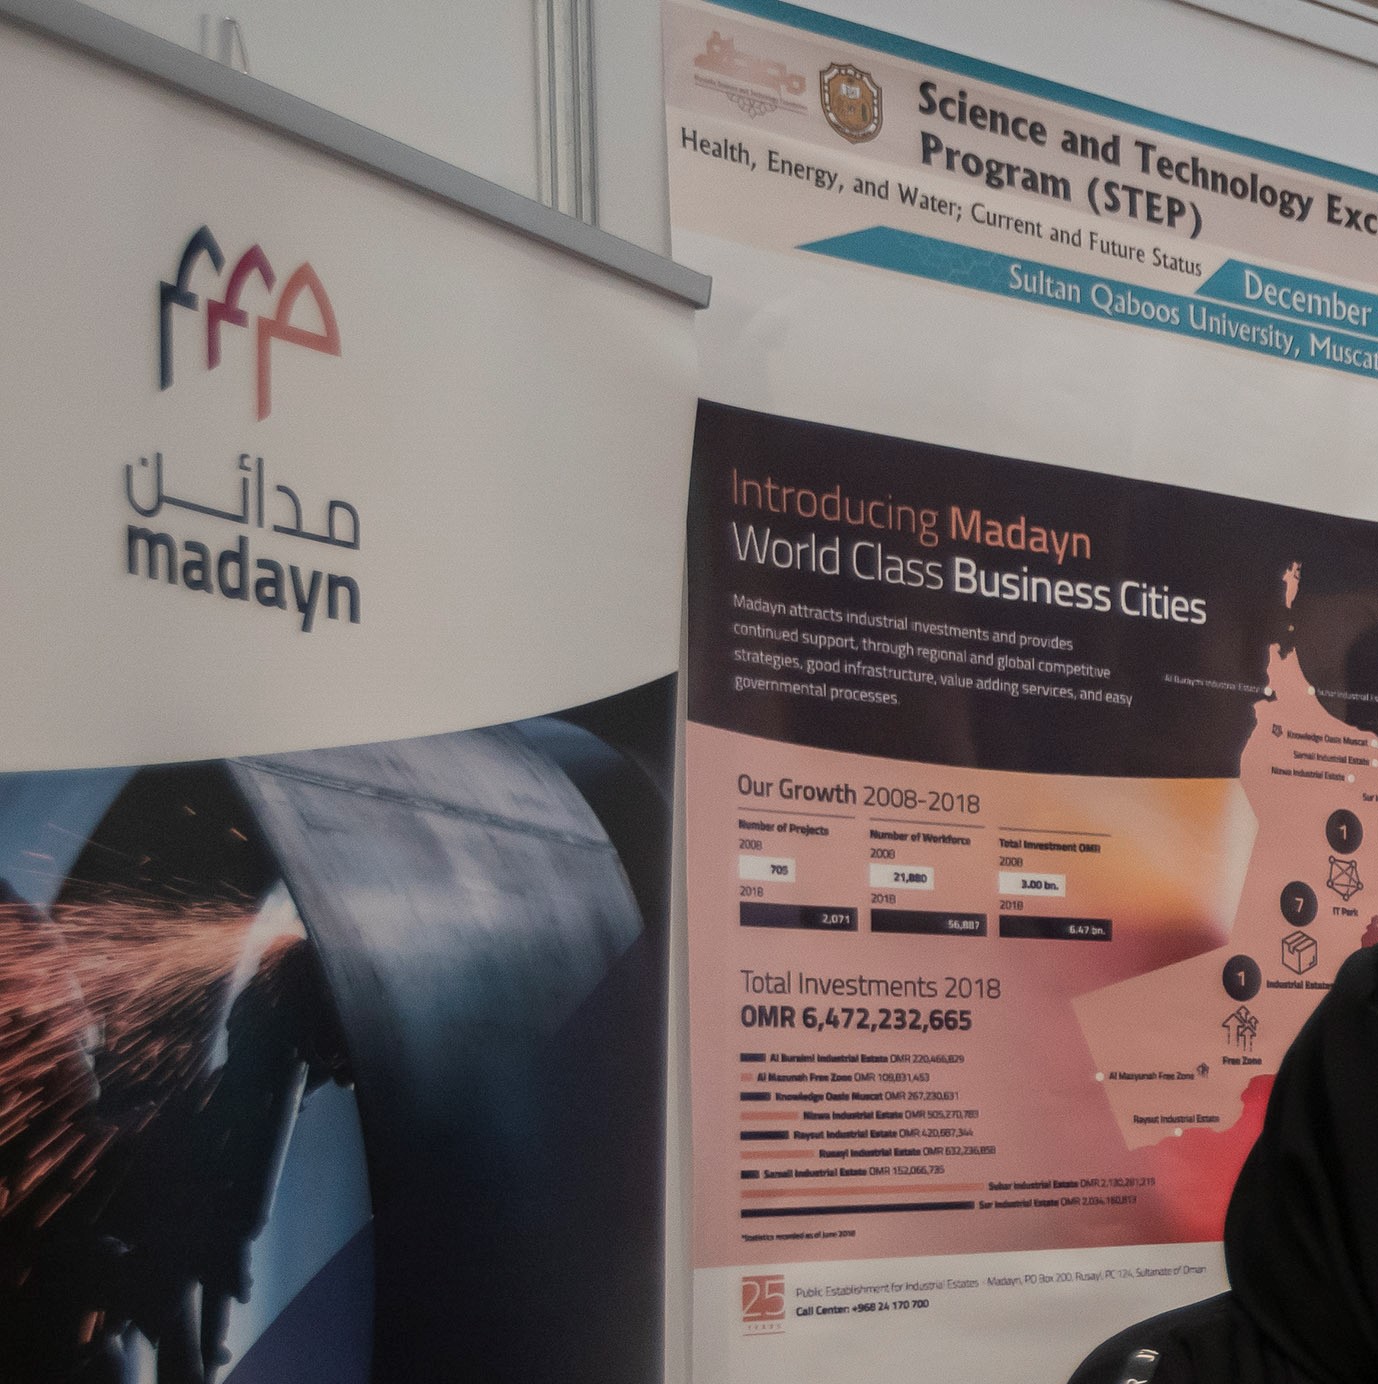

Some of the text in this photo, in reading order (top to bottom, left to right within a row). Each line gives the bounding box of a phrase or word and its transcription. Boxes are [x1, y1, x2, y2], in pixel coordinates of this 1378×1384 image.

[918, 80, 1048, 147] Science
[1061, 131, 1121, 168] and
[1134, 140, 1314, 222] Technology
[919, 130, 1203, 240] Program (STEP)
[680, 126, 1203, 277] Health, Energy, and Water; Current and Future Status
[1009, 263, 1081, 304] Sultan
[1090, 283, 1181, 326] Qaboos
[1188, 303, 1301, 359] University,
[1243, 269, 1372, 327] December
[124, 452, 361, 551] مدائن
[732, 468, 1092, 566] Introducing Madayn
[126, 523, 361, 633] madayn
[732, 521, 1208, 626] World Class Business Cities
[732, 593, 1074, 651] Madayn attracts industrial investments and provides
[732, 622, 1111, 680] continued support, through regional and global competitive
[733, 648, 1133, 708] strategies, good infrastructure, value adding services, and easy
[734, 675, 899, 705] governmental processes
[737, 774, 981, 814] Our Growth 2008-2018
[738, 819, 829, 837] Number of Projects
[869, 829, 972, 846] Number of Workforce
[1338, 824, 1348, 841] 1
[739, 839, 763, 850] 2008
[870, 848, 895, 859] 2008
[999, 838, 1077, 853] Total Investment
[999, 856, 1023, 867] 2008
[740, 886, 764, 898] 2018
[871, 893, 896, 904] 2018
[1000, 900, 1024, 910] 2018
[1293, 897, 1305, 914] 7
[822, 913, 851, 924] 2,071
[740, 969, 1002, 999] Total Investments 2018
[1236, 970, 1246, 987] 1
[740, 1004, 973, 1033] OMR 6,472,232,665
[742, 1279, 785, 1318] 25
[796, 1299, 929, 1317] Call Center: +968 24 170 700
